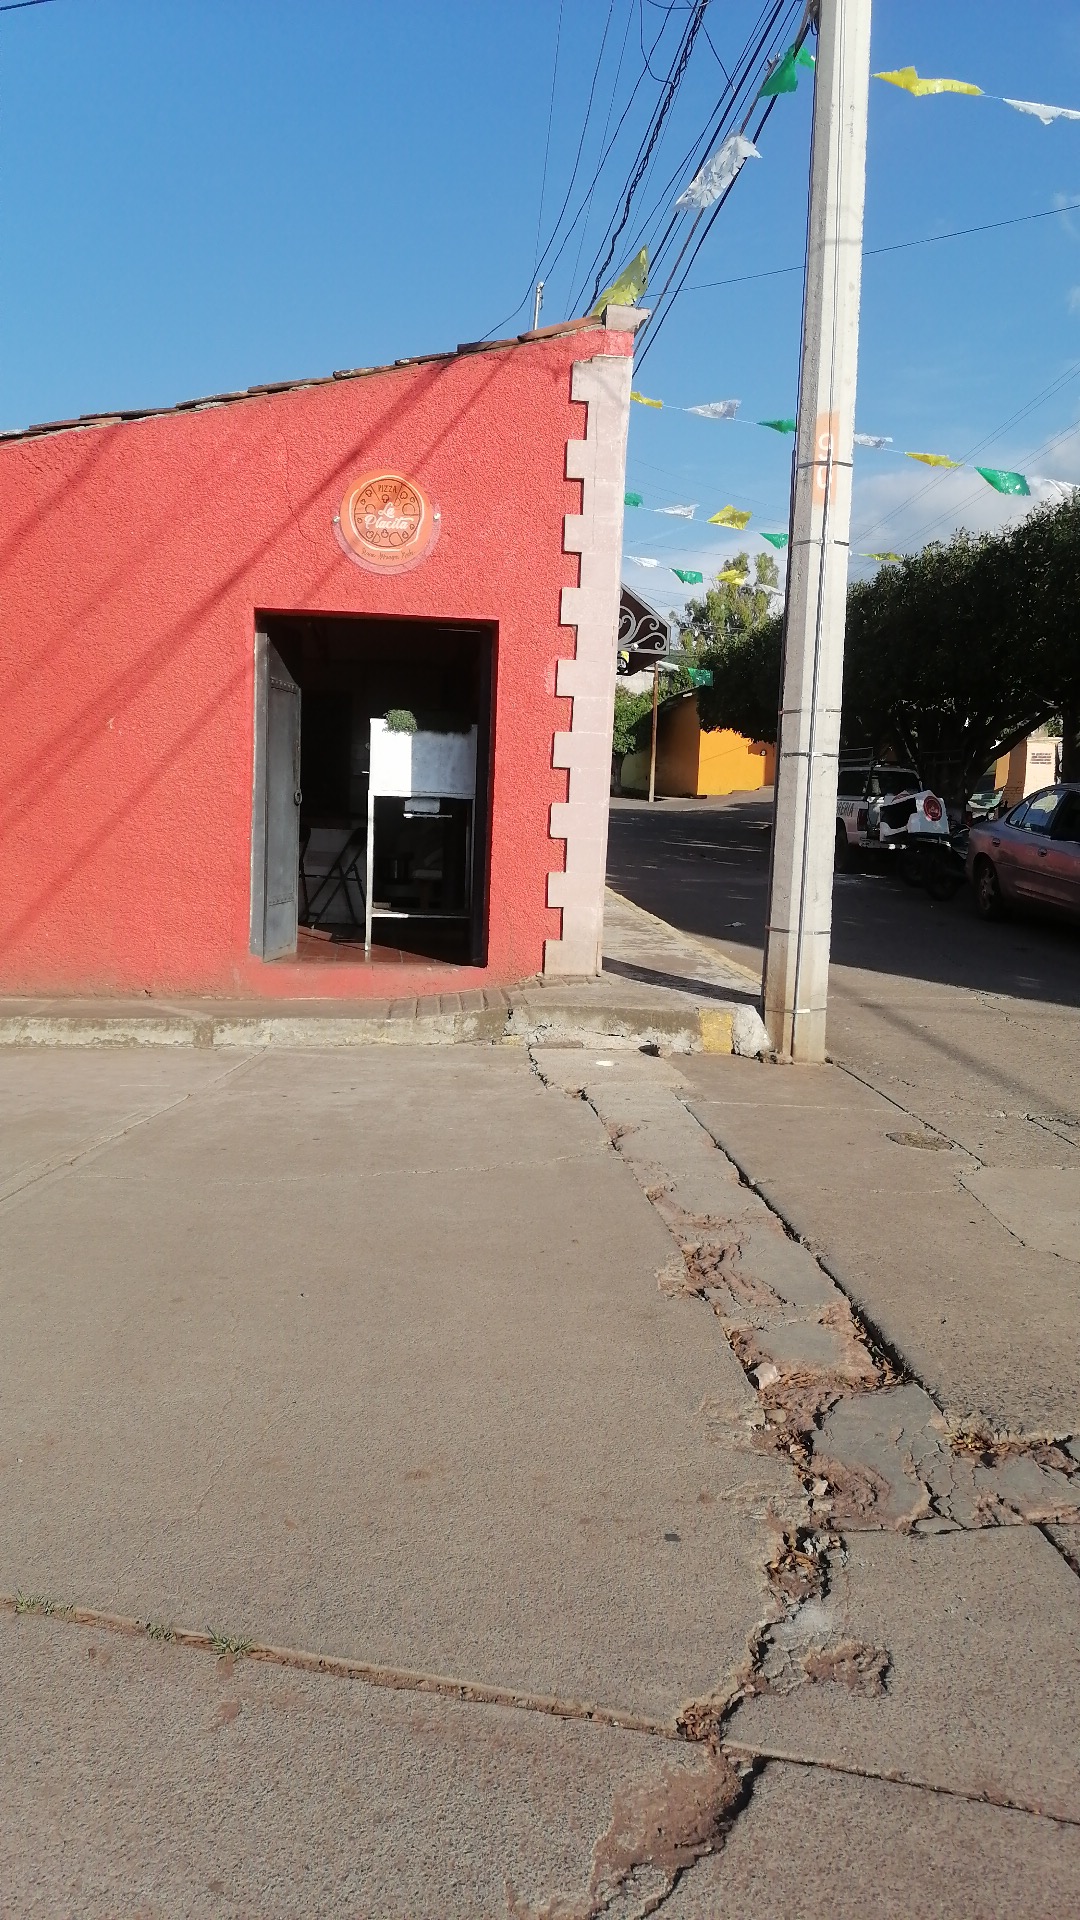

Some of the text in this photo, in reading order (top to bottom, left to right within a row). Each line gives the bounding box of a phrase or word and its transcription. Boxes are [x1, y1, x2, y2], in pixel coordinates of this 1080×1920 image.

[378, 484, 398, 494] PIZZA
[378, 501, 395, 519] La
[365, 515, 414, 529] Placita
